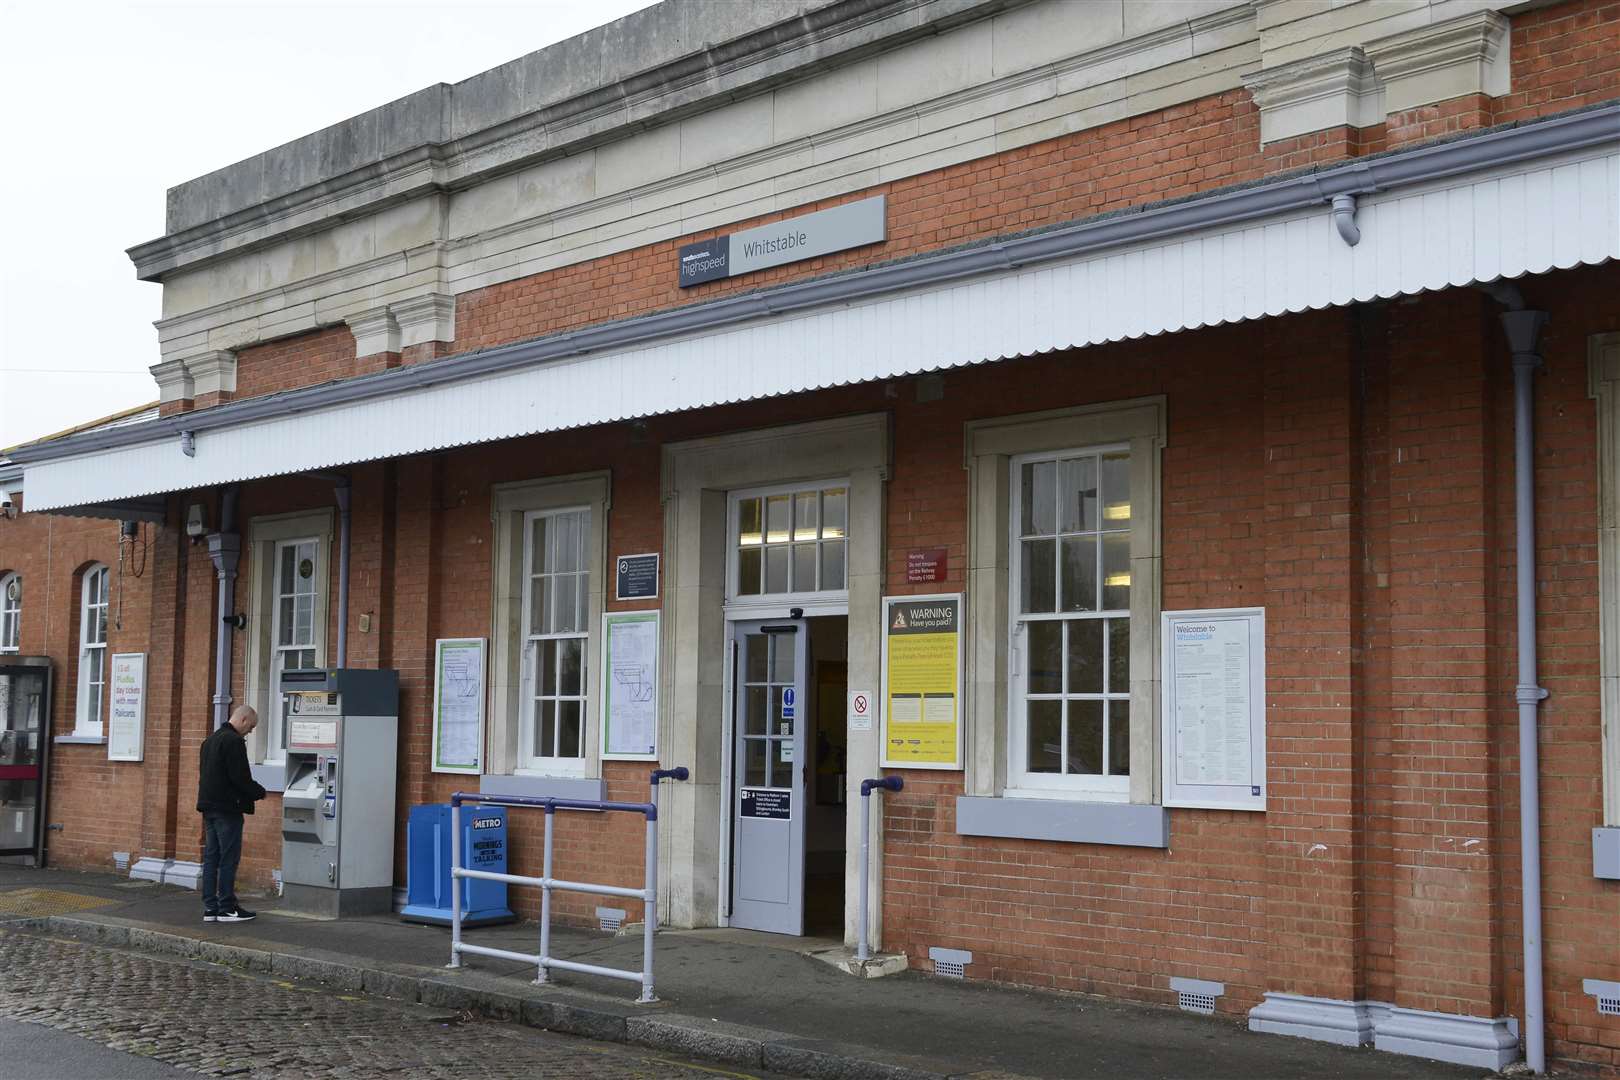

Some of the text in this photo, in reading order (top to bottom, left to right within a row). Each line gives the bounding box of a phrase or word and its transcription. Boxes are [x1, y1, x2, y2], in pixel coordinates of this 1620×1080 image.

[743, 231, 807, 259] Whitstable
[682, 253, 726, 277] highspeed
[910, 607, 952, 619] WARNING
[910, 618, 952, 628] Have you paid?
[1177, 624, 1216, 633] Welcome to
[474, 818, 501, 829] METRO
